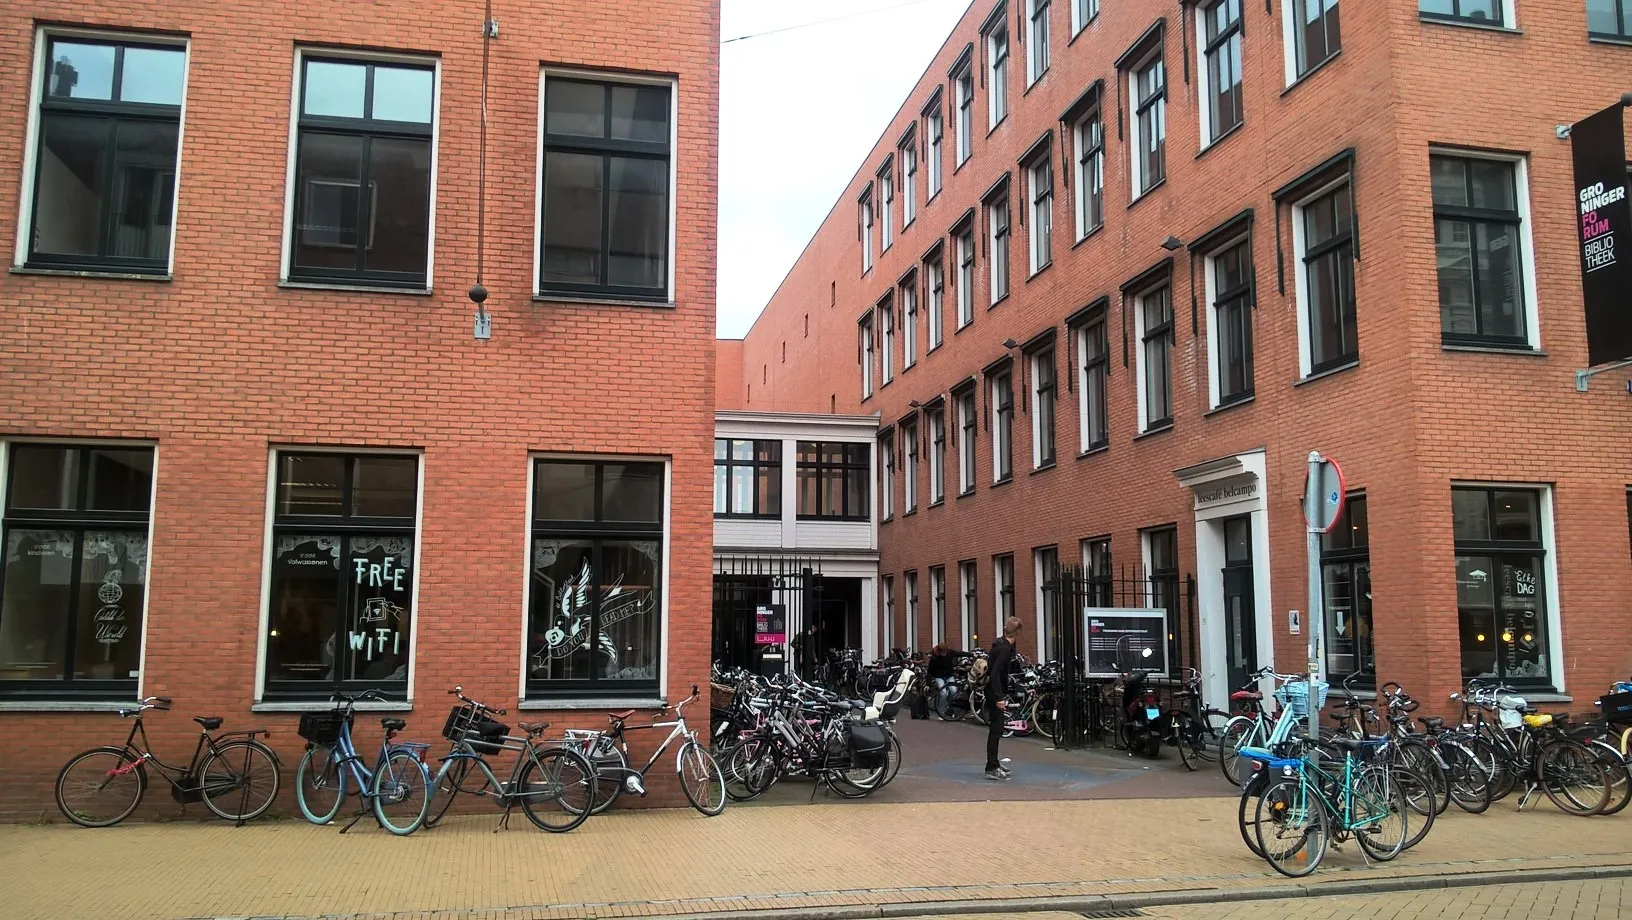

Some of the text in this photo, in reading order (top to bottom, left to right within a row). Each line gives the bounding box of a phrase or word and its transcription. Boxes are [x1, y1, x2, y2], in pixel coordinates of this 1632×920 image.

[1580, 181, 1604, 202] GRO
[1580, 186, 1625, 215] NINGER
[1582, 210, 1597, 227] FO
[1583, 218, 1609, 240] RUM
[1584, 236, 1614, 257] BIBLIO
[1585, 247, 1615, 269] THEEK
[1224, 483, 1257, 498] belcampo
[353, 557, 405, 591] FREE
[1514, 570, 1536, 585] Elke
[1517, 582, 1536, 595] DAG
[601, 604, 635, 625] READ ME?
[349, 628, 400, 660] WIFI
[569, 632, 587, 649] YOU
